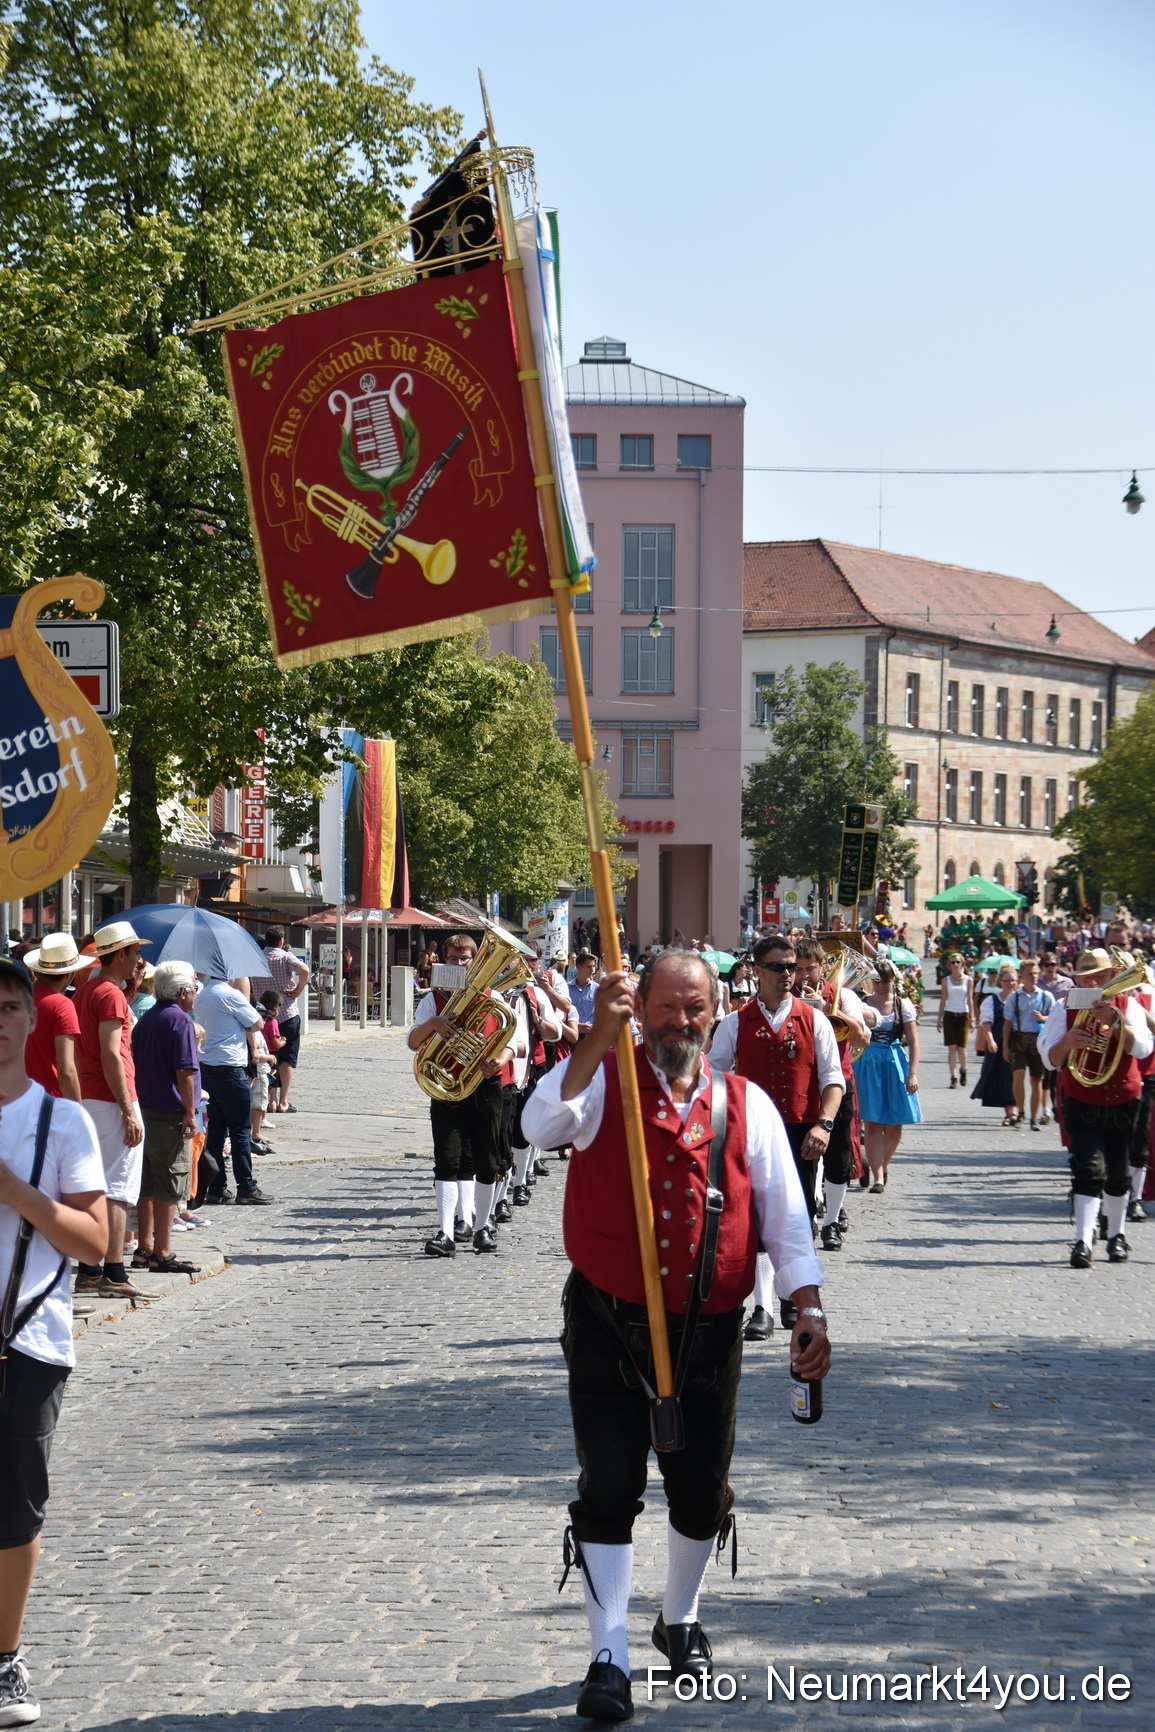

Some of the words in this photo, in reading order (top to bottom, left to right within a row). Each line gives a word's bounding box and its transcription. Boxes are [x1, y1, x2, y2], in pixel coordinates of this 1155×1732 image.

[270, 406, 302, 458] Uns
[297, 336, 384, 404] verbindet
[389, 336, 418, 363] die
[421, 342, 485, 412] Musik
[246, 728, 264, 857] GEREI
[613, 815, 676, 834] kasse
